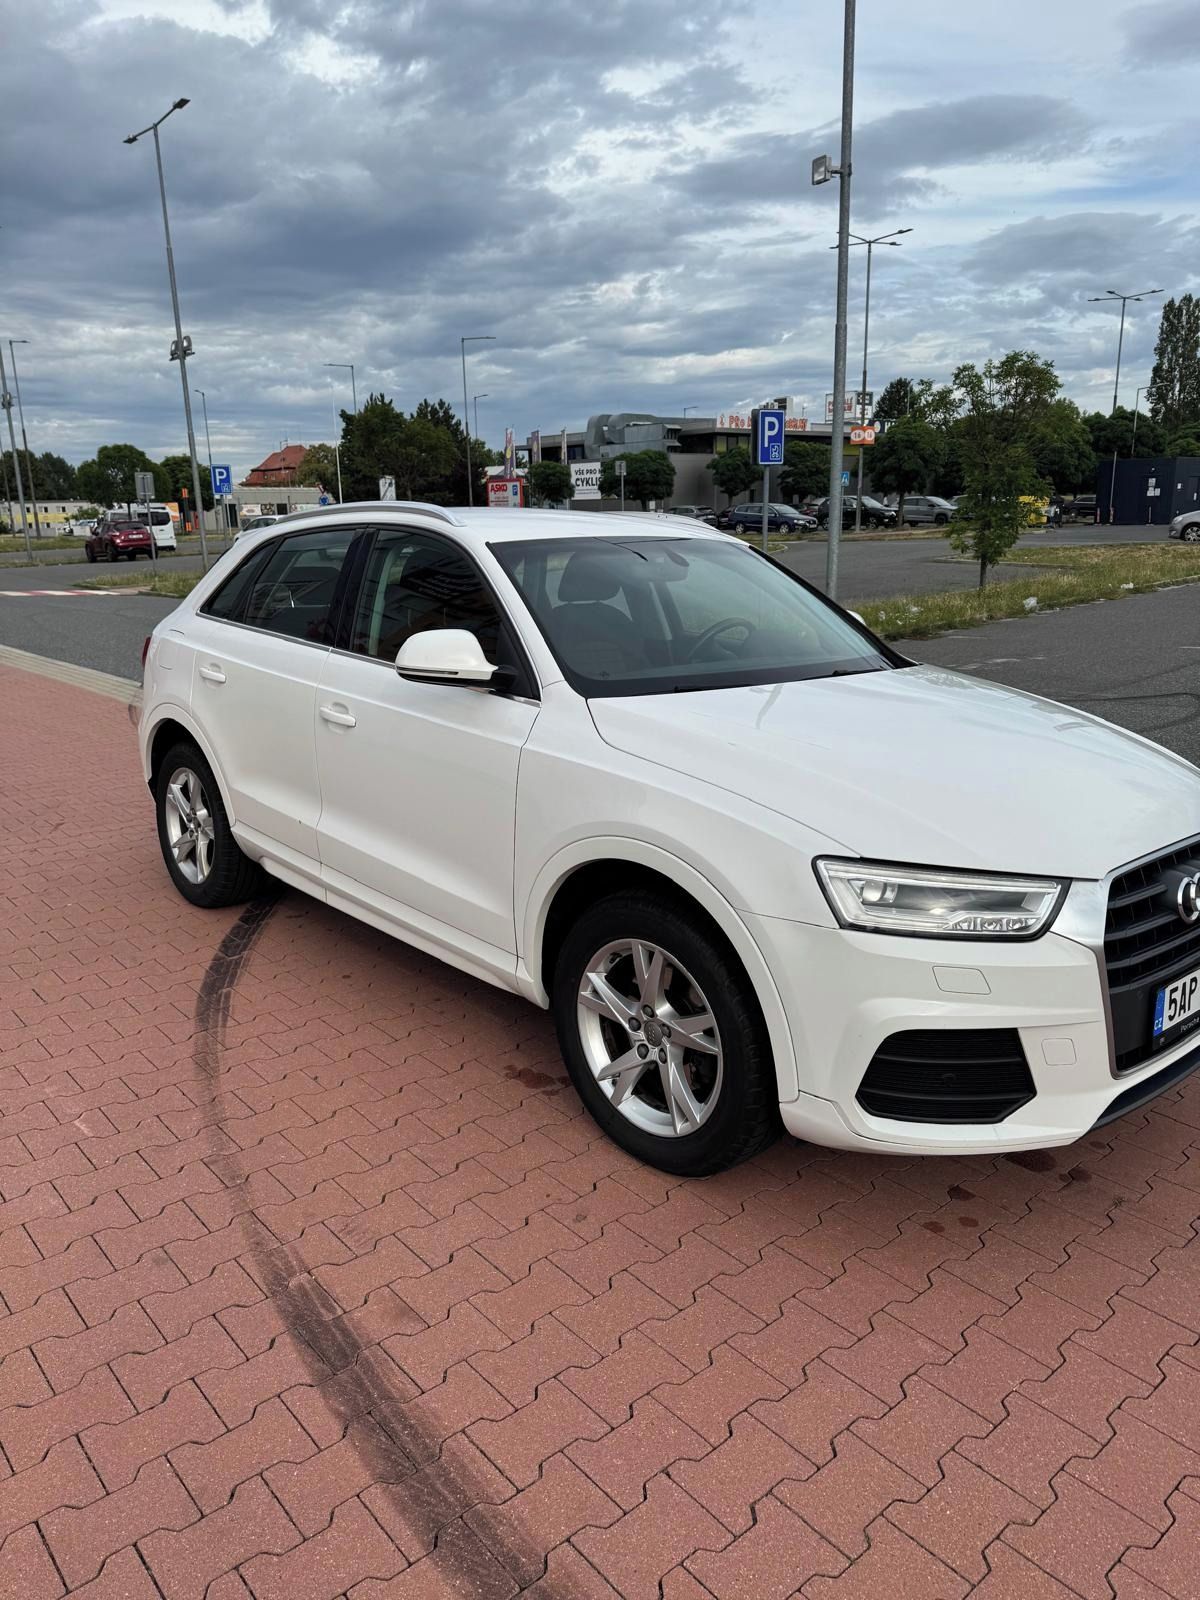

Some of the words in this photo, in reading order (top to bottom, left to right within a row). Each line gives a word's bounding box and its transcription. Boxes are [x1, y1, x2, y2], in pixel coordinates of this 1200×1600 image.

[764, 416, 780, 448] P
[215, 468, 227, 486] P
[574, 467, 585, 476] VŠE
[585, 468, 598, 476] PRO
[1168, 976, 1198, 1022] 5AP
[1154, 1017, 1163, 1031] CZ
